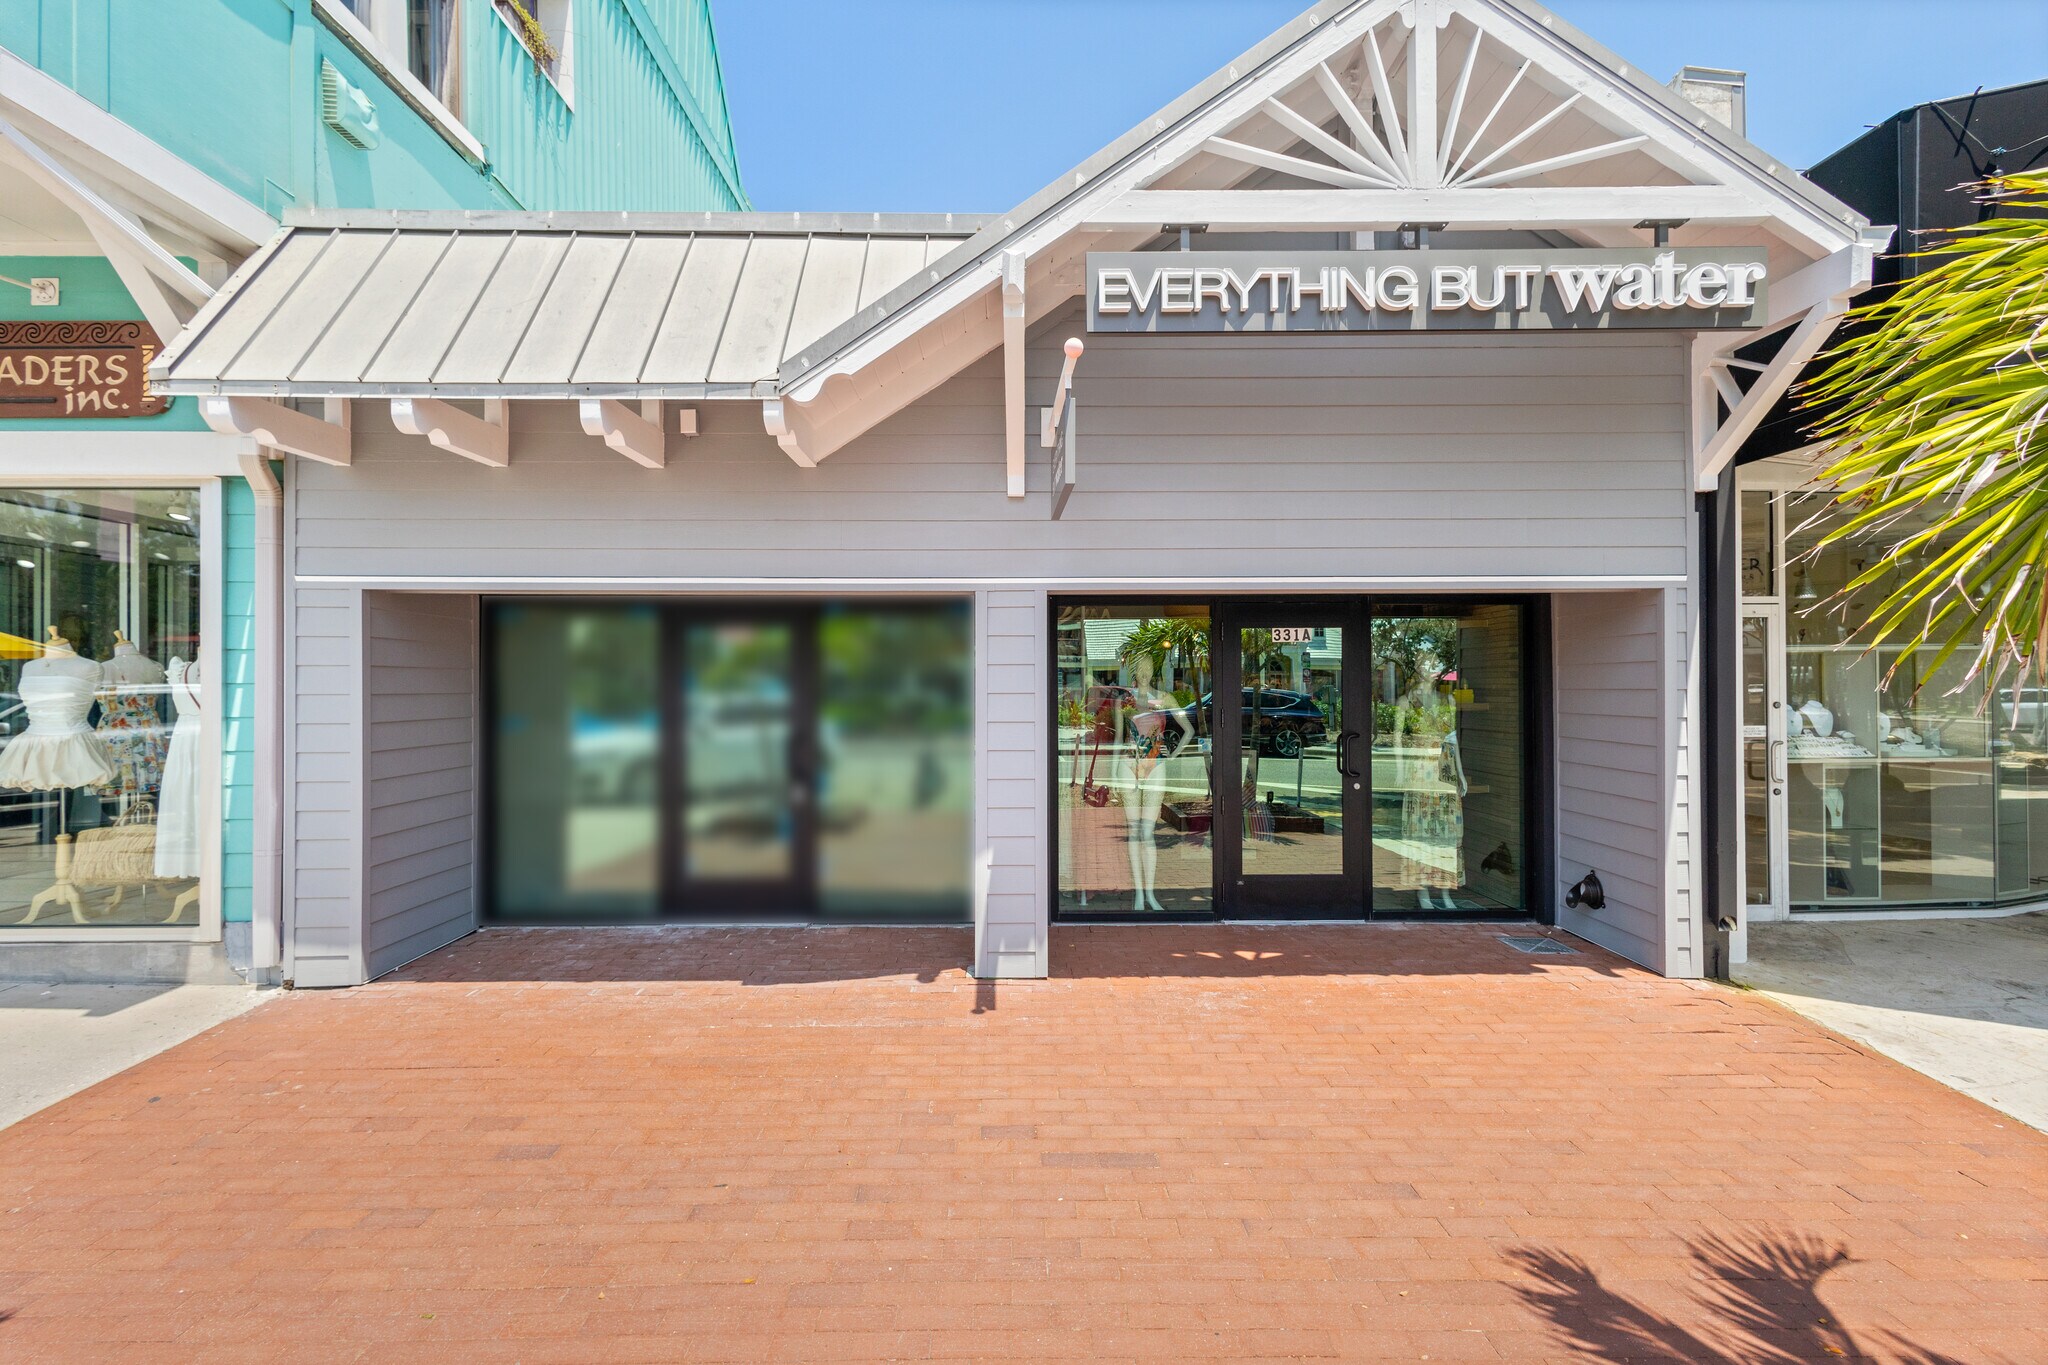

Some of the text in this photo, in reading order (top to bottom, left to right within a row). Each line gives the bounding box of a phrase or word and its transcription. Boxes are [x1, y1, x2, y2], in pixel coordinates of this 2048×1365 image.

[1098, 250, 1766, 314] EVERYTHING BUT water
[0, 354, 129, 386] ADERS
[65, 386, 130, 415] inc.
[1273, 629, 1311, 641] 331A
